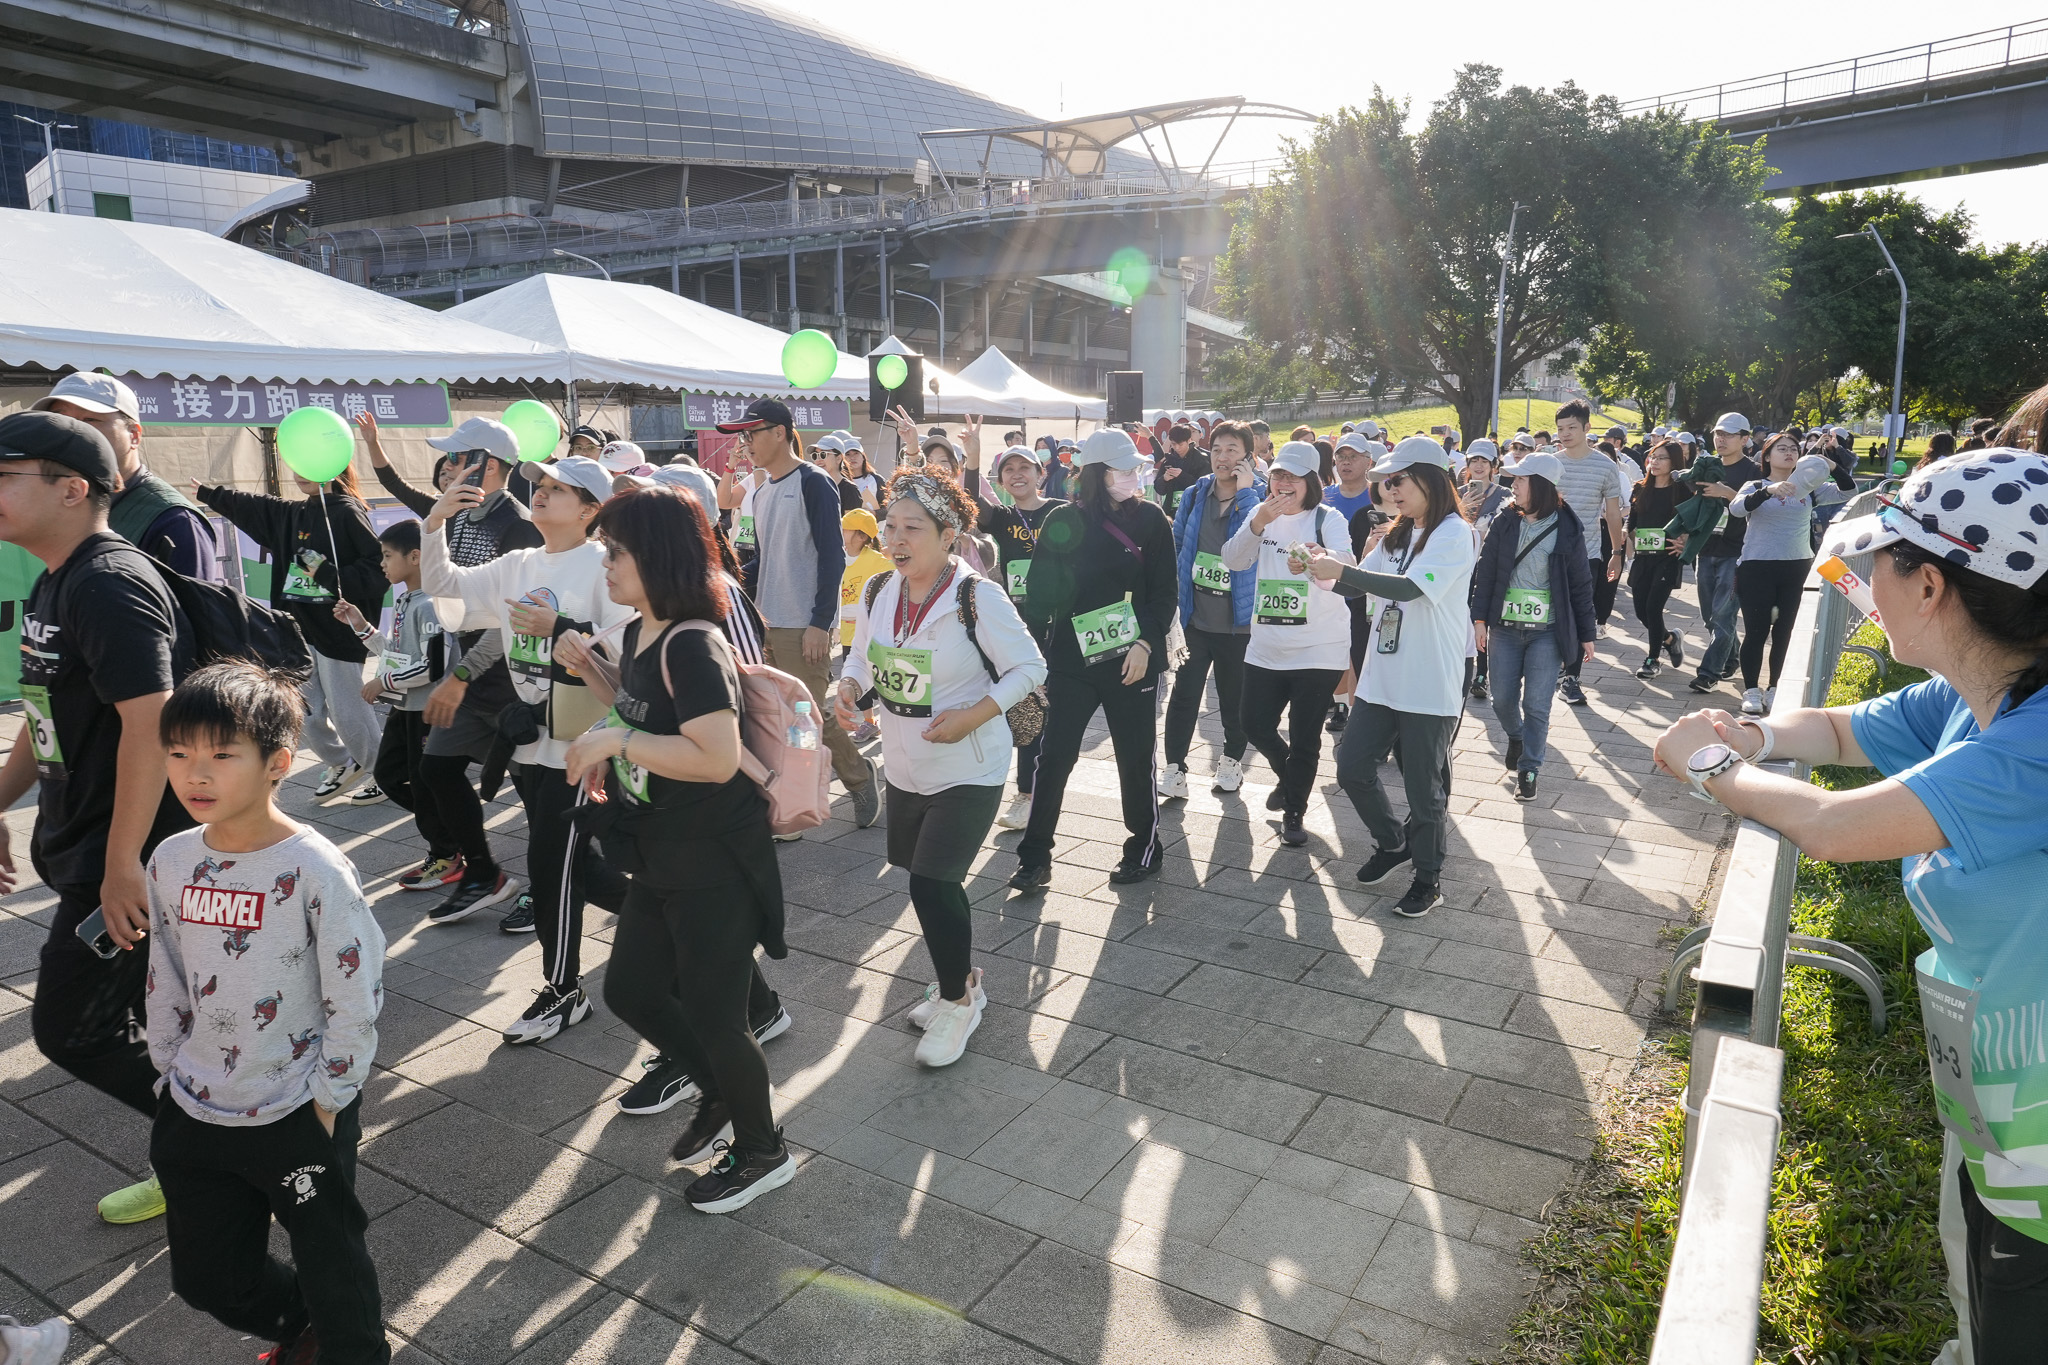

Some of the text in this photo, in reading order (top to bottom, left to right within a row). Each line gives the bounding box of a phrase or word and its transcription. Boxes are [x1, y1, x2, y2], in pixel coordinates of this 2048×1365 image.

[138, 404, 159, 414] UN
[1638, 537, 1660, 546] 1445
[1199, 567, 1231, 584] 1488
[1263, 595, 1299, 610] 2053
[1508, 602, 1542, 616] 1136
[872, 664, 919, 694] 2437
[428, 864, 448, 877] FILA
[182, 887, 260, 927] MARVEL
[283, 1164, 326, 1182] BATHING
